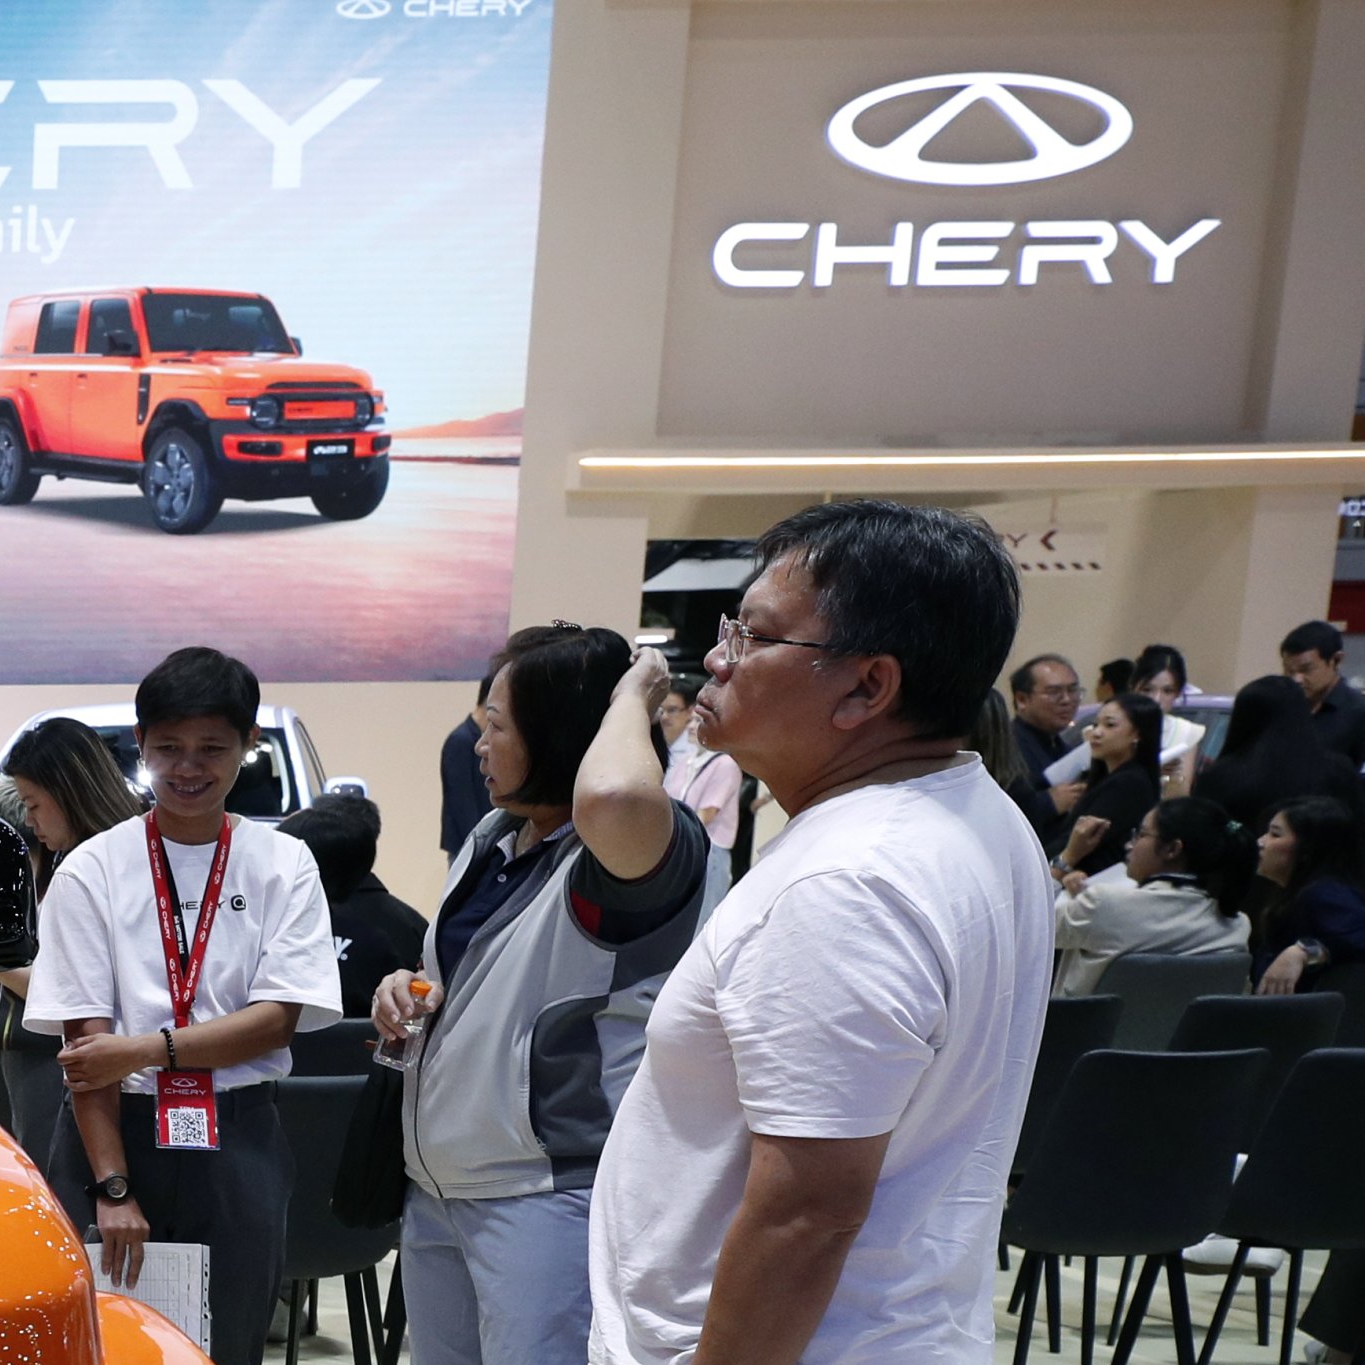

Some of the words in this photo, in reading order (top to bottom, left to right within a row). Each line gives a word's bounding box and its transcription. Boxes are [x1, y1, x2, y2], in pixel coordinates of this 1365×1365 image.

[403, 0, 532, 17] CHERY
[712, 220, 1221, 288] CHERY
[152, 852, 162, 880] CHERY
[217, 844, 226, 871] CHERY
[162, 910, 172, 940] CHERY
[203, 901, 213, 929] CHERY
[171, 973, 180, 1002] CHER
[187, 959, 197, 988] CHERY
[163, 1087, 207, 1096] CHERY
